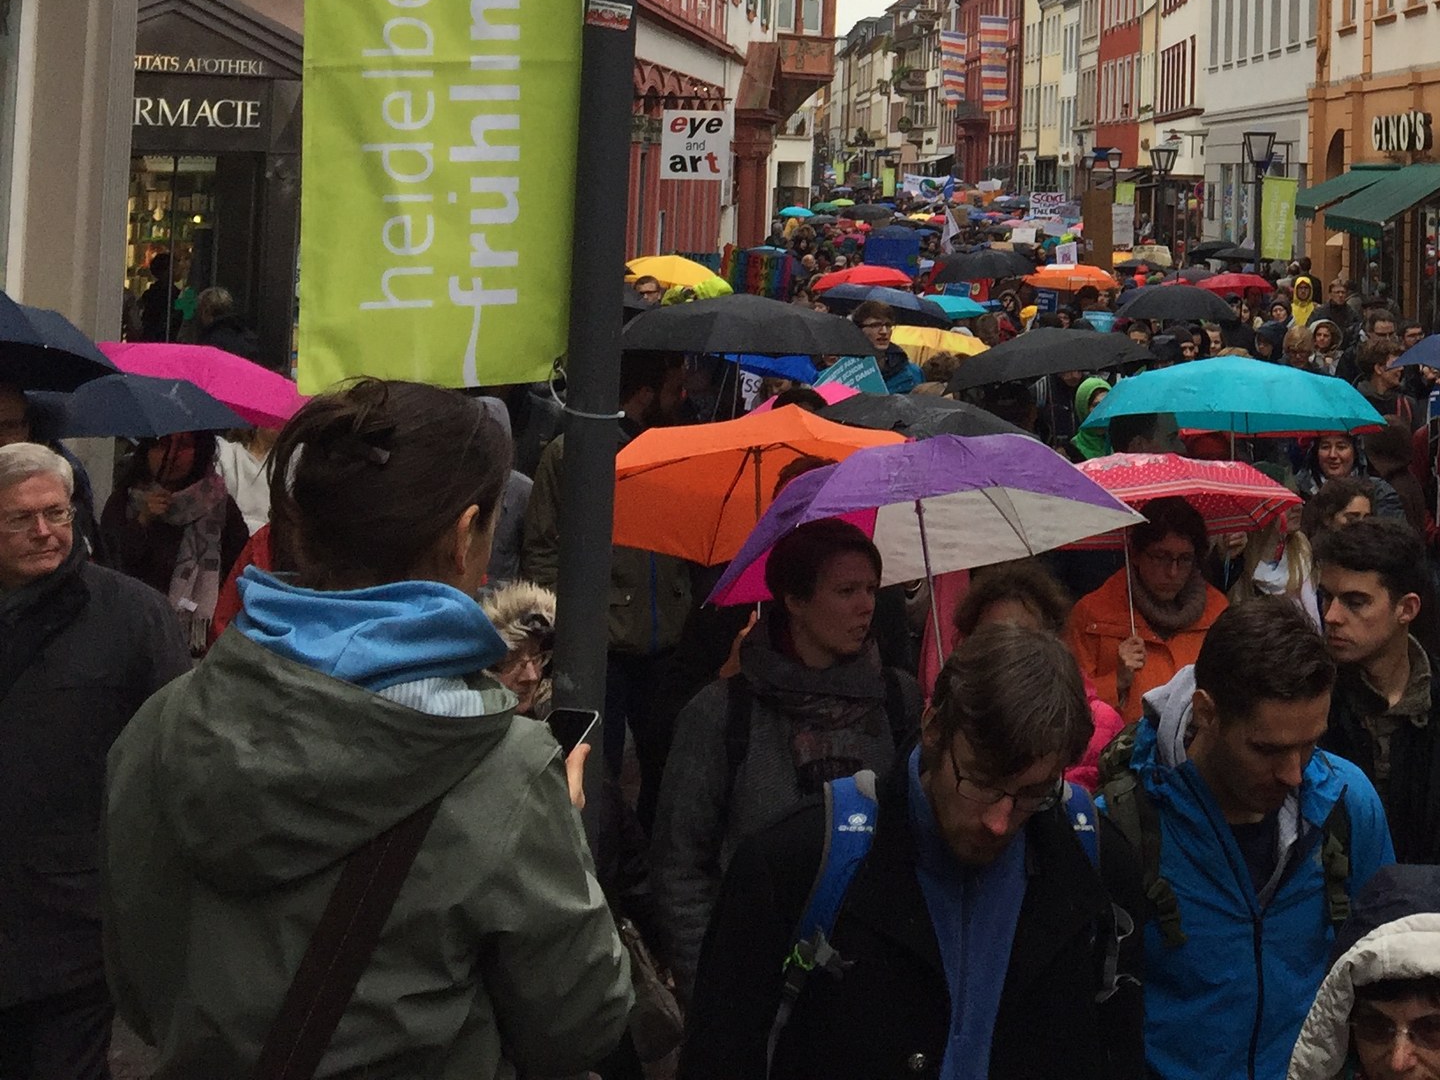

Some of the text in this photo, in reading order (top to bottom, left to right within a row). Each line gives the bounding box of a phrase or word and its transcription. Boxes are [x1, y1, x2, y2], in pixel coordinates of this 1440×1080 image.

[669, 116, 724, 139] eye
[1371, 110, 1425, 151] GINO'S
[685, 140, 706, 151] and
[669, 151, 720, 174] art
